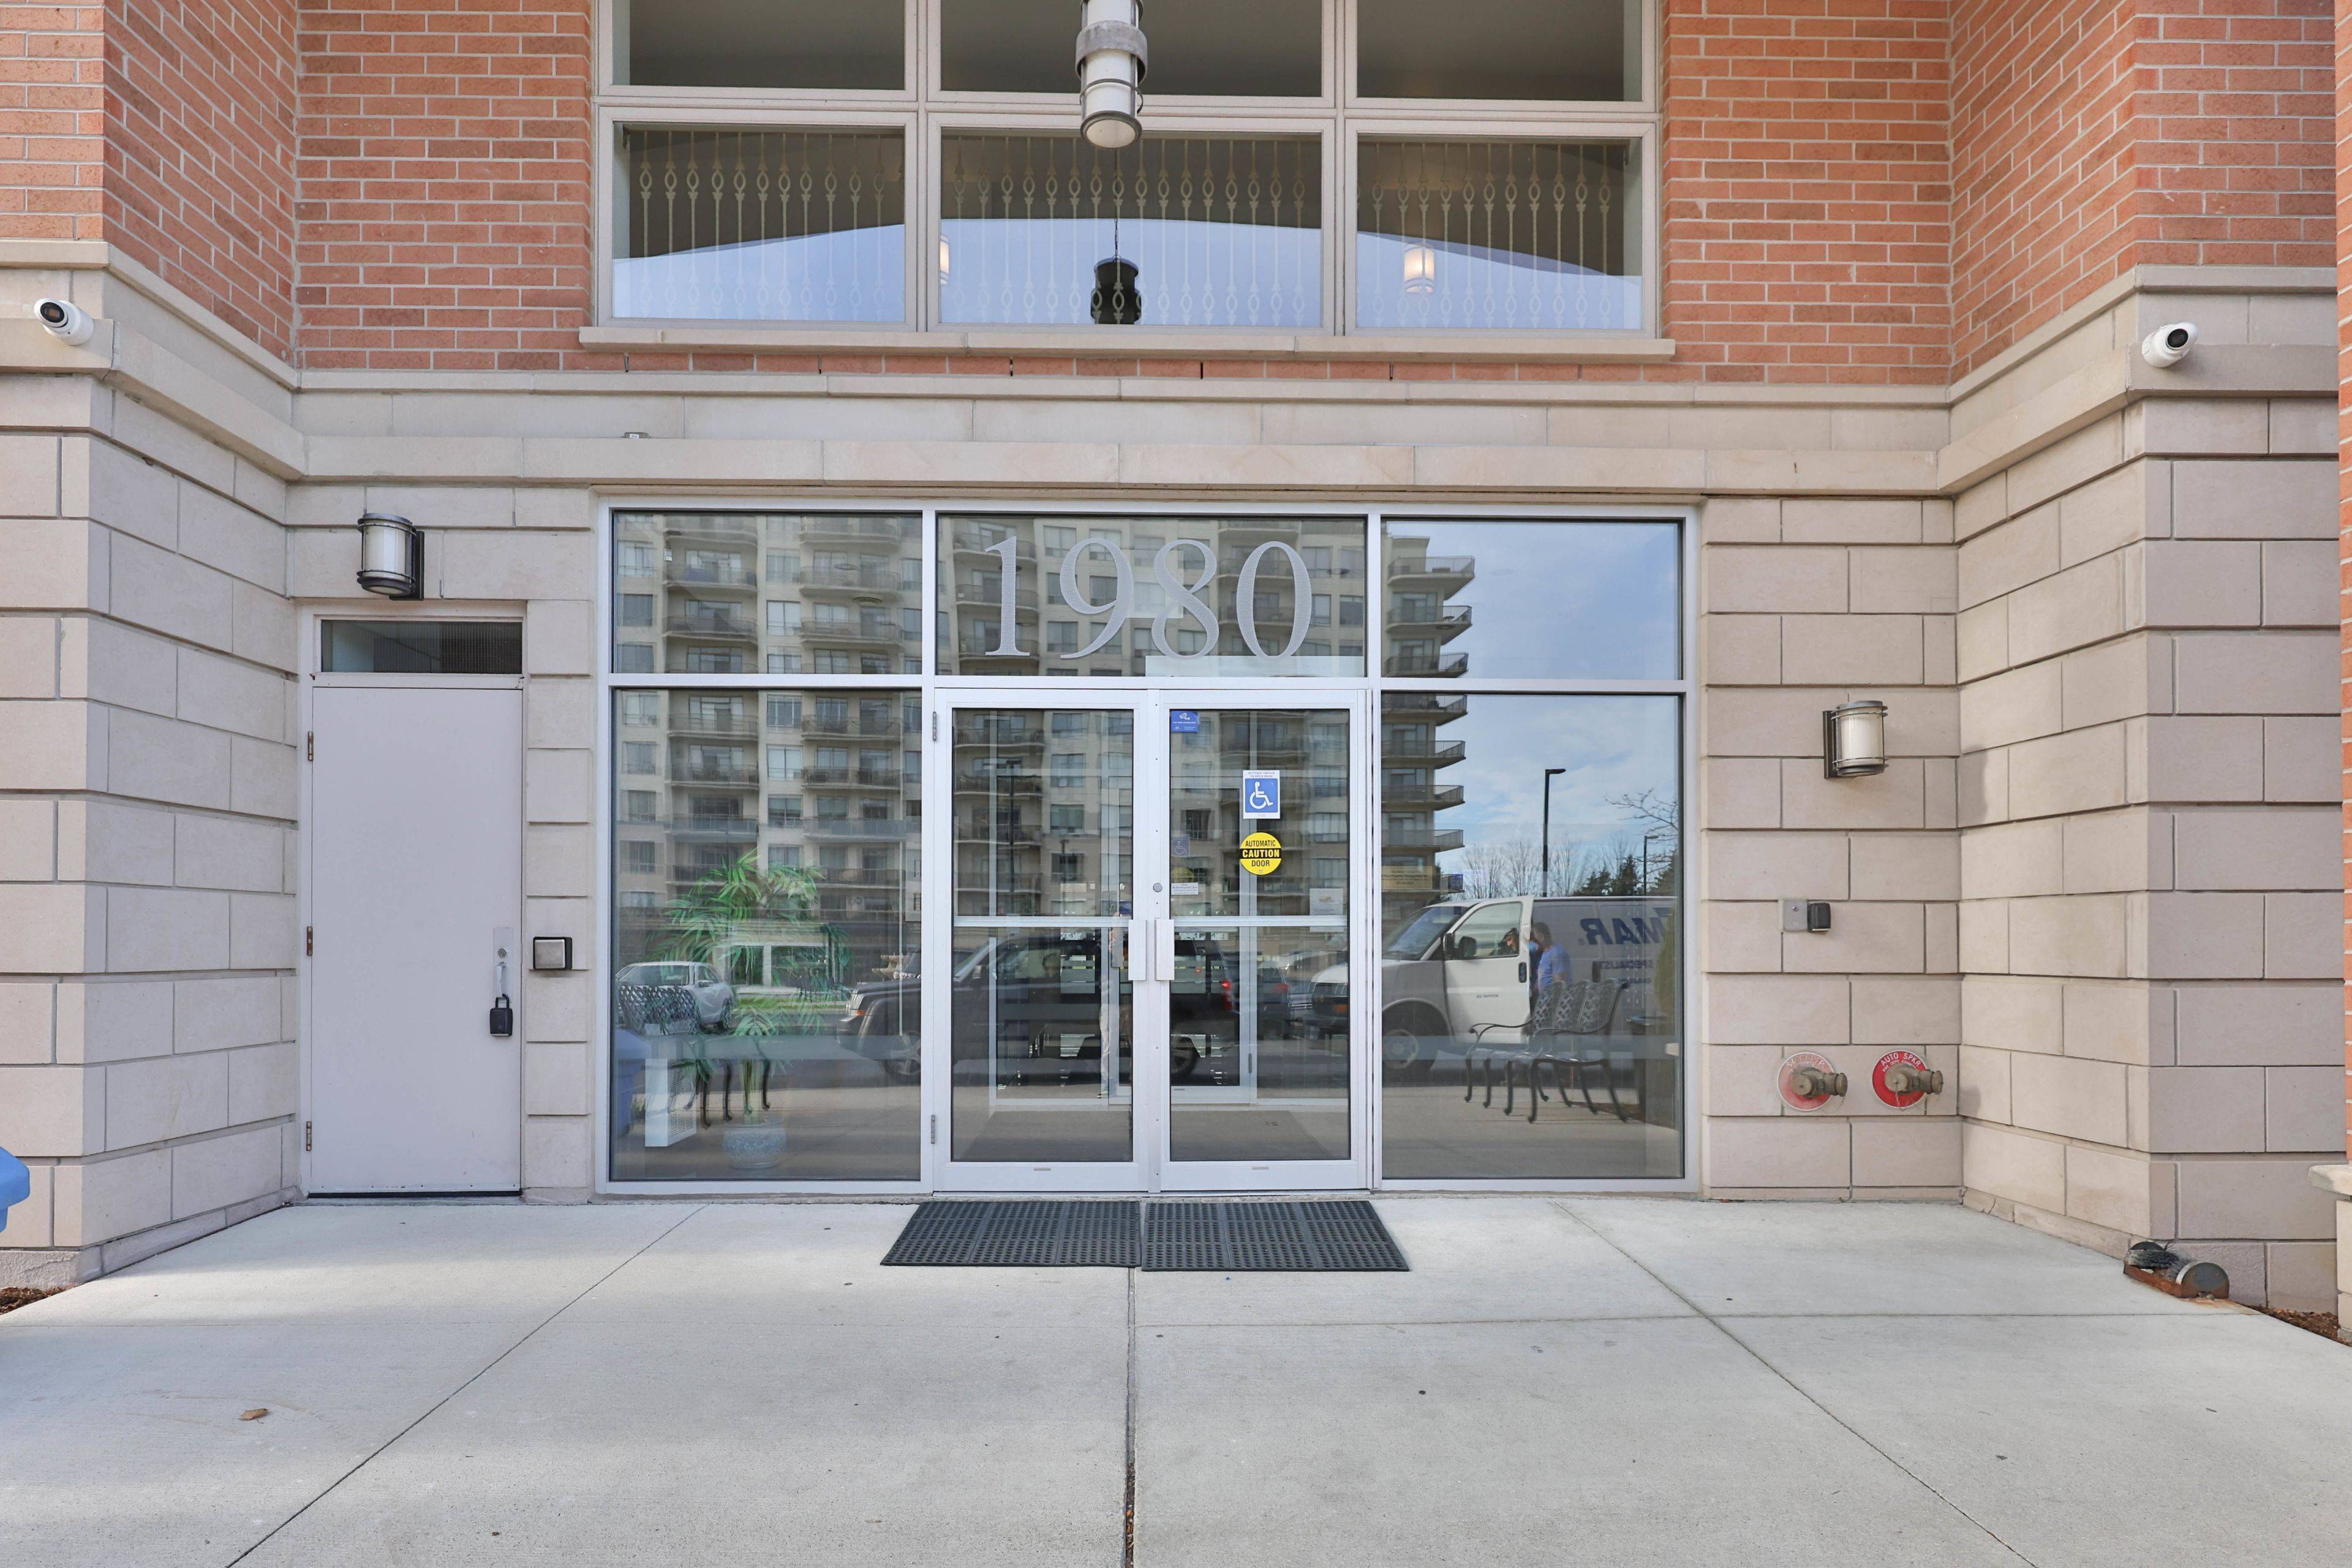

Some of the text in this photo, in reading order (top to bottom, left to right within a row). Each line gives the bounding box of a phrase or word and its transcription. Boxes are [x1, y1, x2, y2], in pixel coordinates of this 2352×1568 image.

[985, 535, 1312, 659] 1980
[1242, 849, 1280, 858] CAUTION
[1880, 1052, 1899, 1066] AUTO
[1903, 1052, 1921, 1067] SPKR
